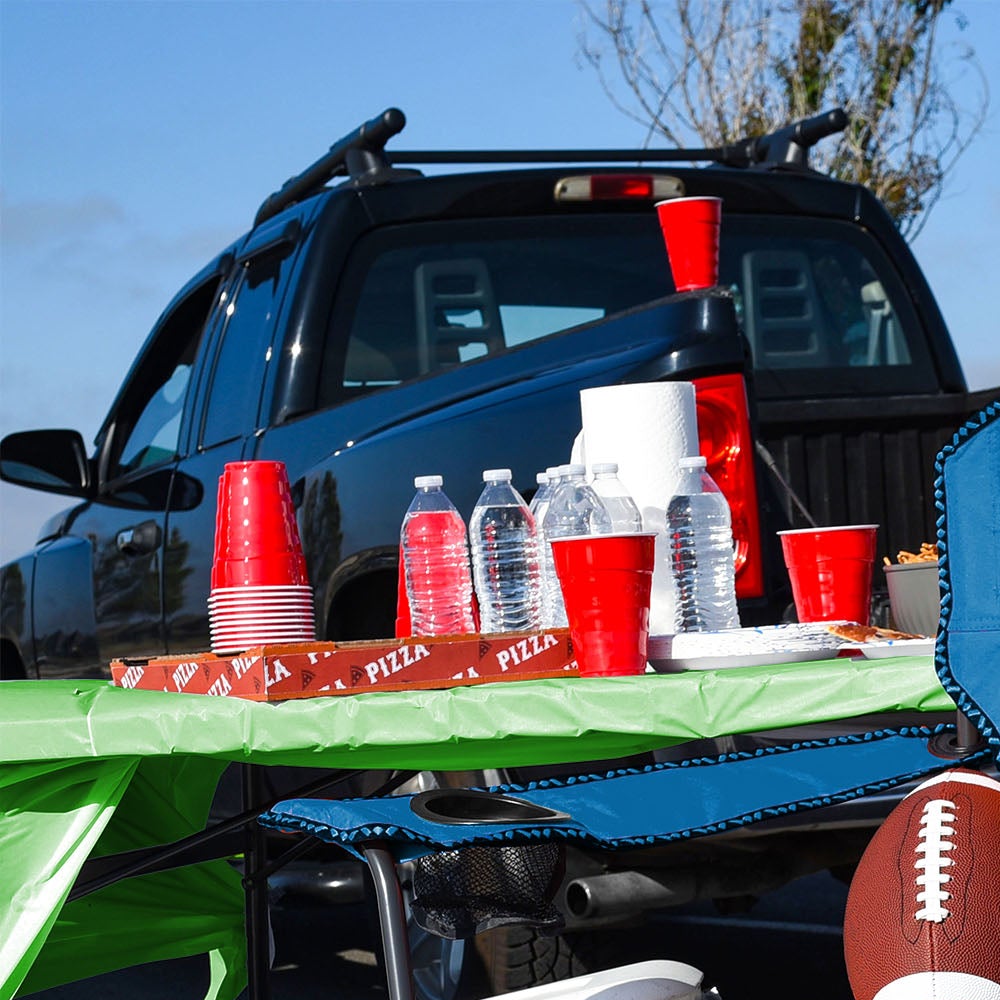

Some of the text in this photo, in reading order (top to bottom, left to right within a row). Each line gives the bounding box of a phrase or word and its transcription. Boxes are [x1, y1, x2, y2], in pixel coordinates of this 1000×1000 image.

[365, 644, 429, 684] PIZZA
[496, 634, 559, 672] PIZZA
[172, 662, 200, 693] PIZZA
